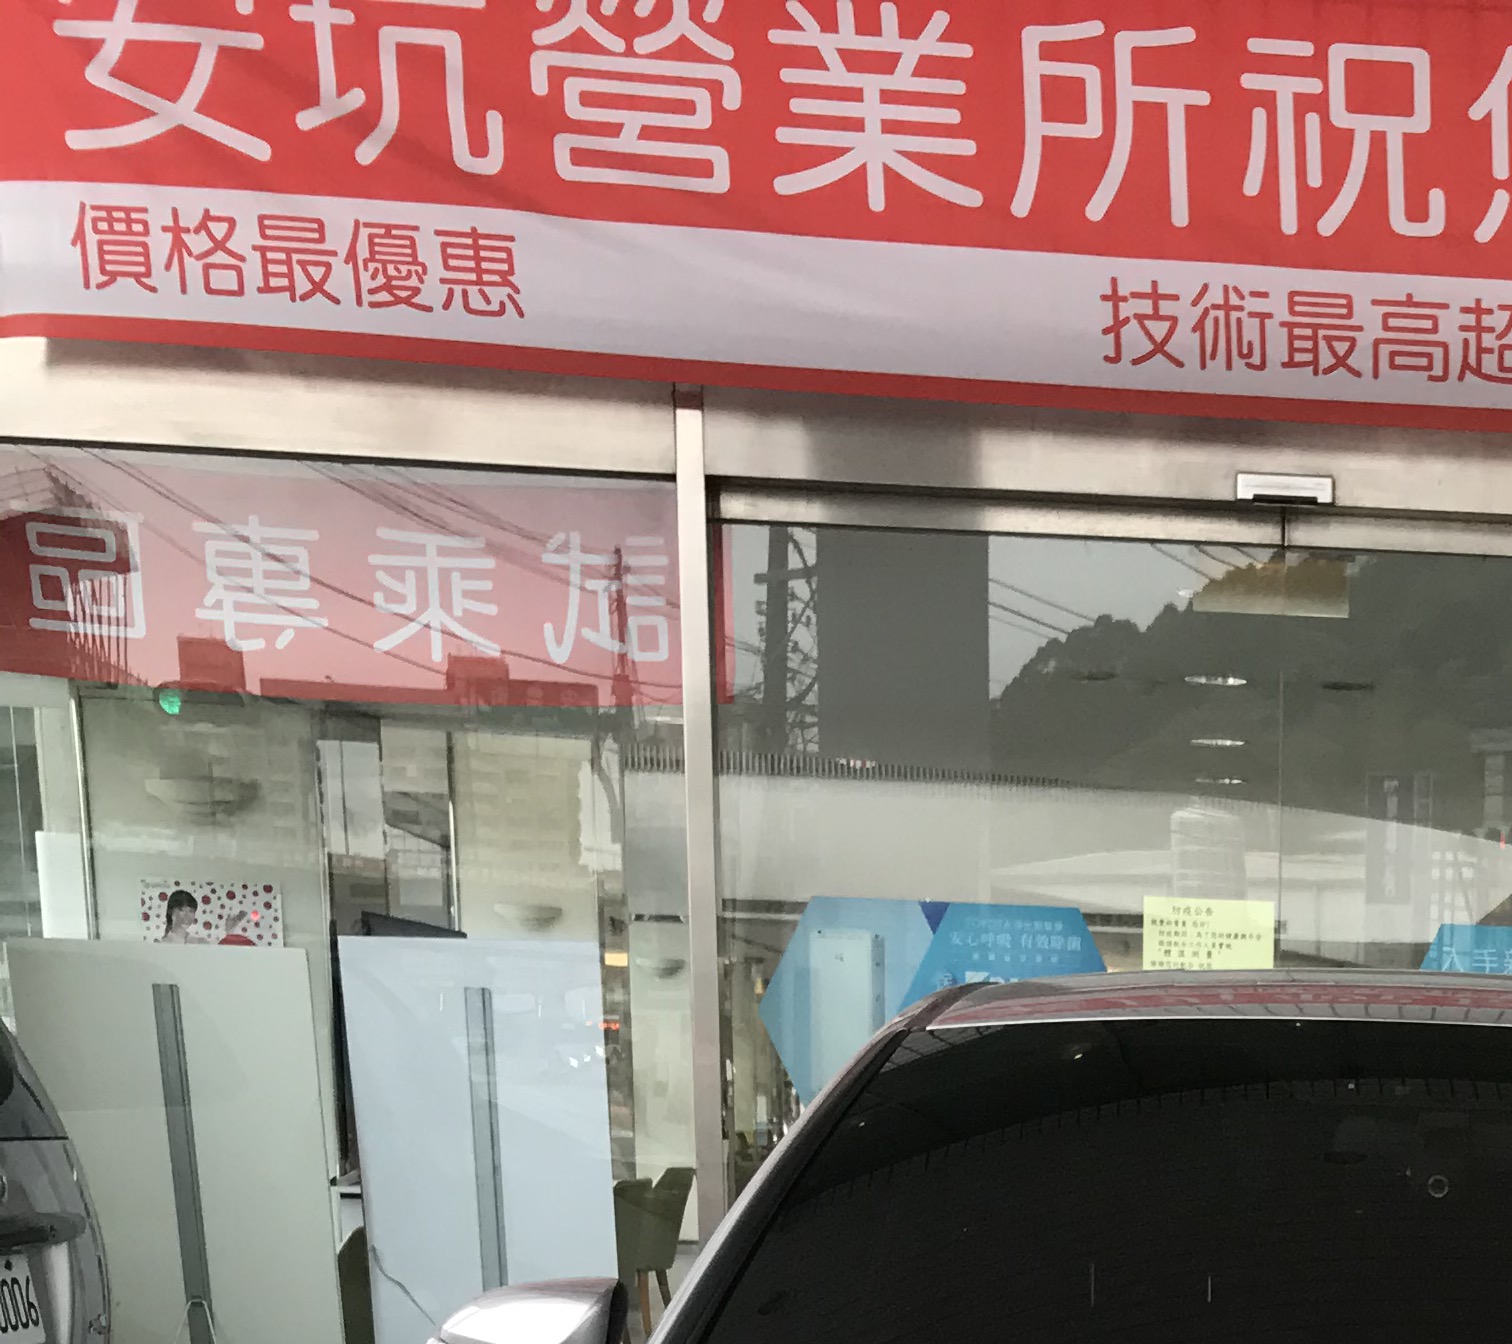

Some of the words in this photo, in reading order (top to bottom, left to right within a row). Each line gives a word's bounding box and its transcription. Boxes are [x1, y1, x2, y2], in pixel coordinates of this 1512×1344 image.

[70, 202, 526, 319] 價格最優惠
